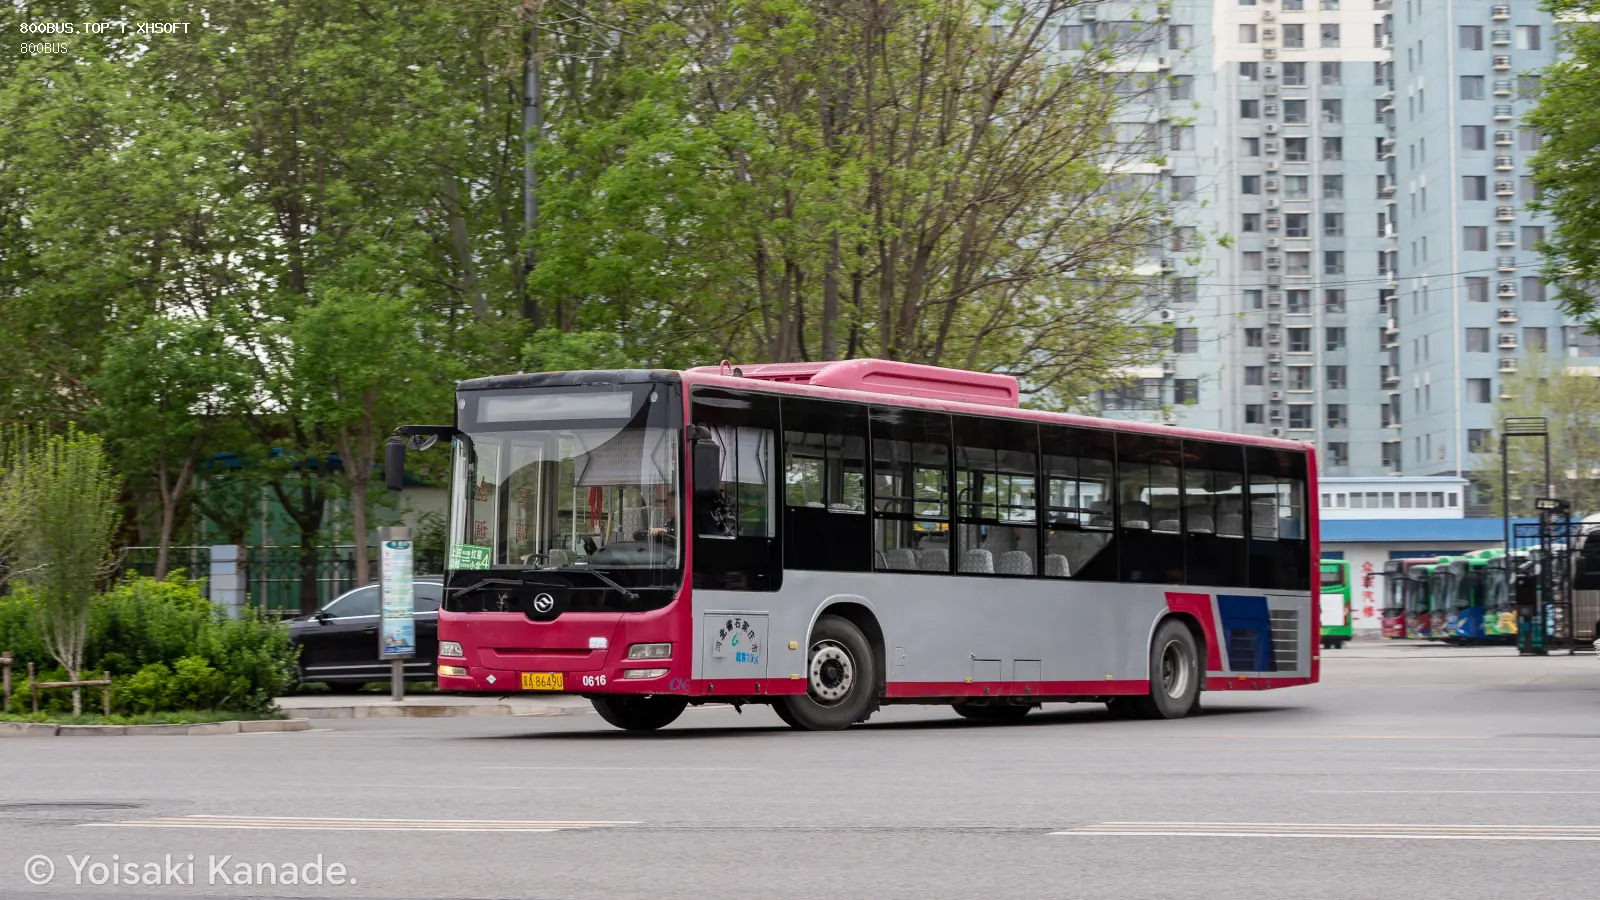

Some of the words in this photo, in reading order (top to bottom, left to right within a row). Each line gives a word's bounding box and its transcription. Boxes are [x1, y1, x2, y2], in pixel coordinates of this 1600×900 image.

[480, 553, 489, 570] 4
[714, 618, 758, 653] 河北省石家庄市
[582, 674, 607, 687] 0616
